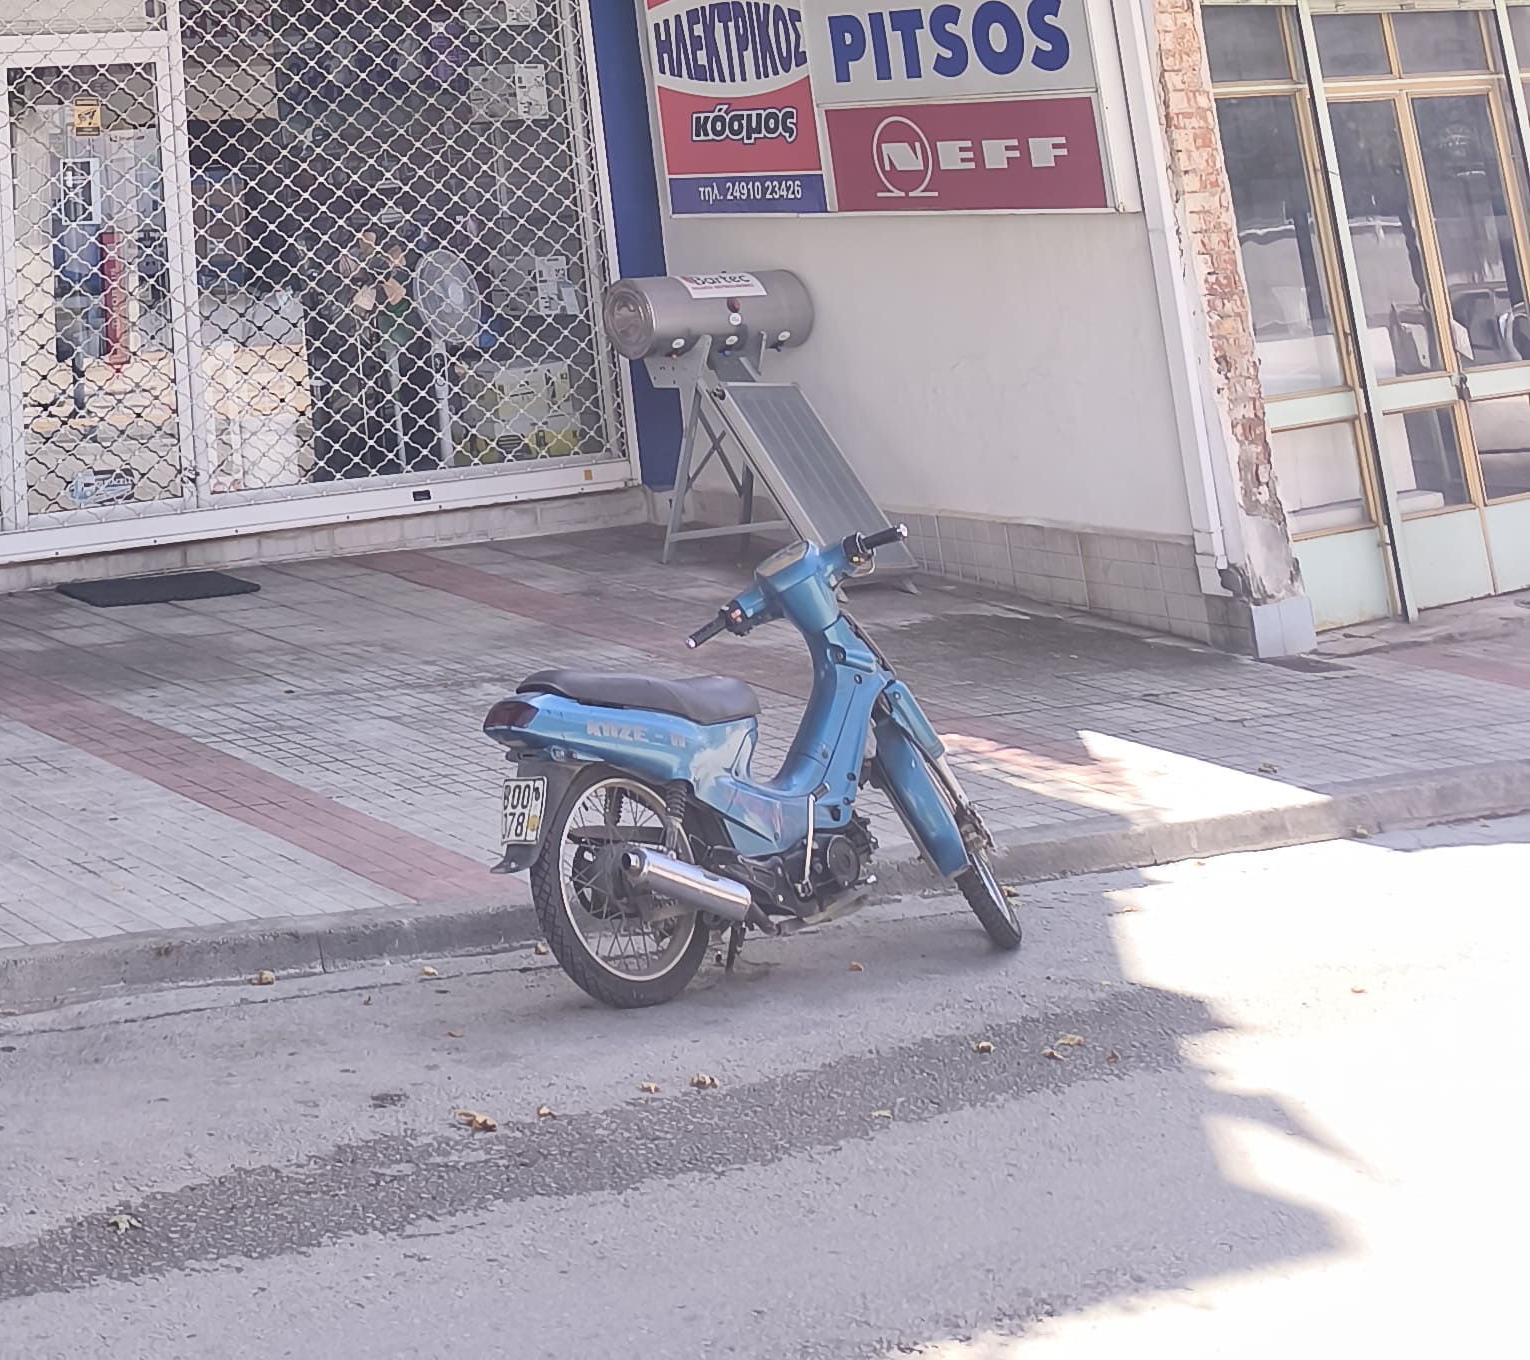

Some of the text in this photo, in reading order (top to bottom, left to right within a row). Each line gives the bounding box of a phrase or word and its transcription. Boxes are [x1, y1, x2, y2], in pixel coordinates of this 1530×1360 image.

[653, 1, 808, 82] ΗΛΕΚΤΡΙΚΟΣ
[692, 104, 797, 144] κόσμος
[881, 137, 1068, 171] NEFF
[698, 180, 802, 205] τηλ. 24910 23426
